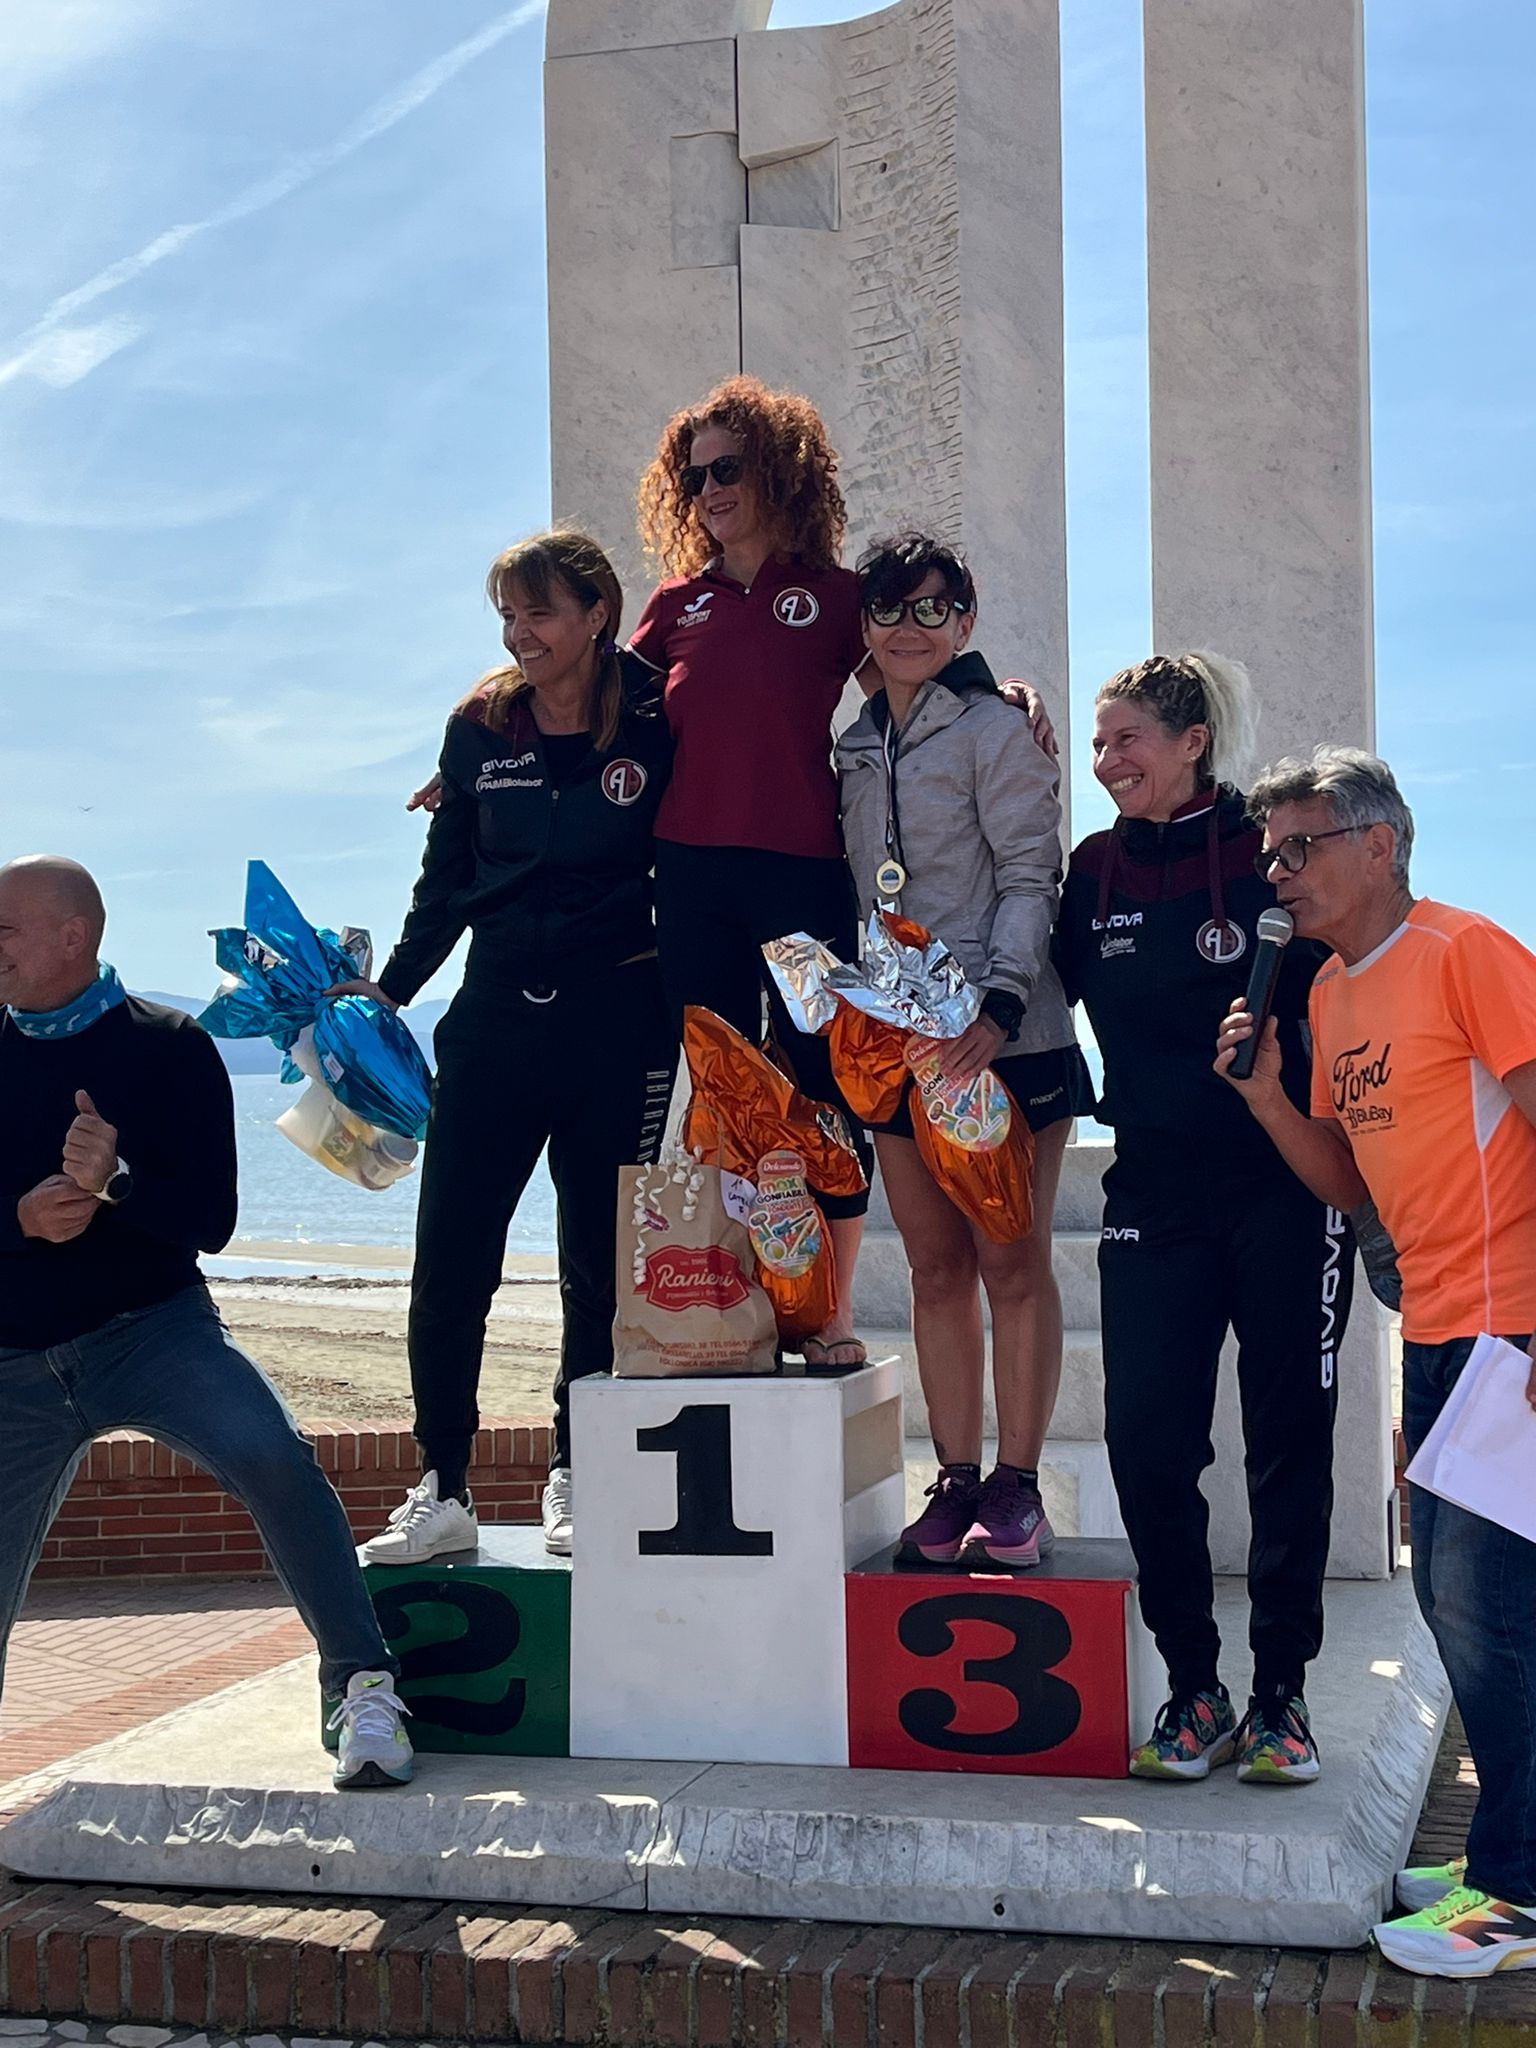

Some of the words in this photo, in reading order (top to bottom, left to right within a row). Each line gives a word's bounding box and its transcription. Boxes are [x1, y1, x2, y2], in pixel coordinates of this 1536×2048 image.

[481, 751, 537, 774] GIVOVA
[1091, 912, 1143, 931] GVOVA
[1332, 1039, 1392, 1113] Ford
[657, 1264, 734, 1289] Ranieri
[636, 1404, 774, 1556] 1
[371, 1580, 527, 1736] 2
[897, 1593, 1083, 1755] 3
